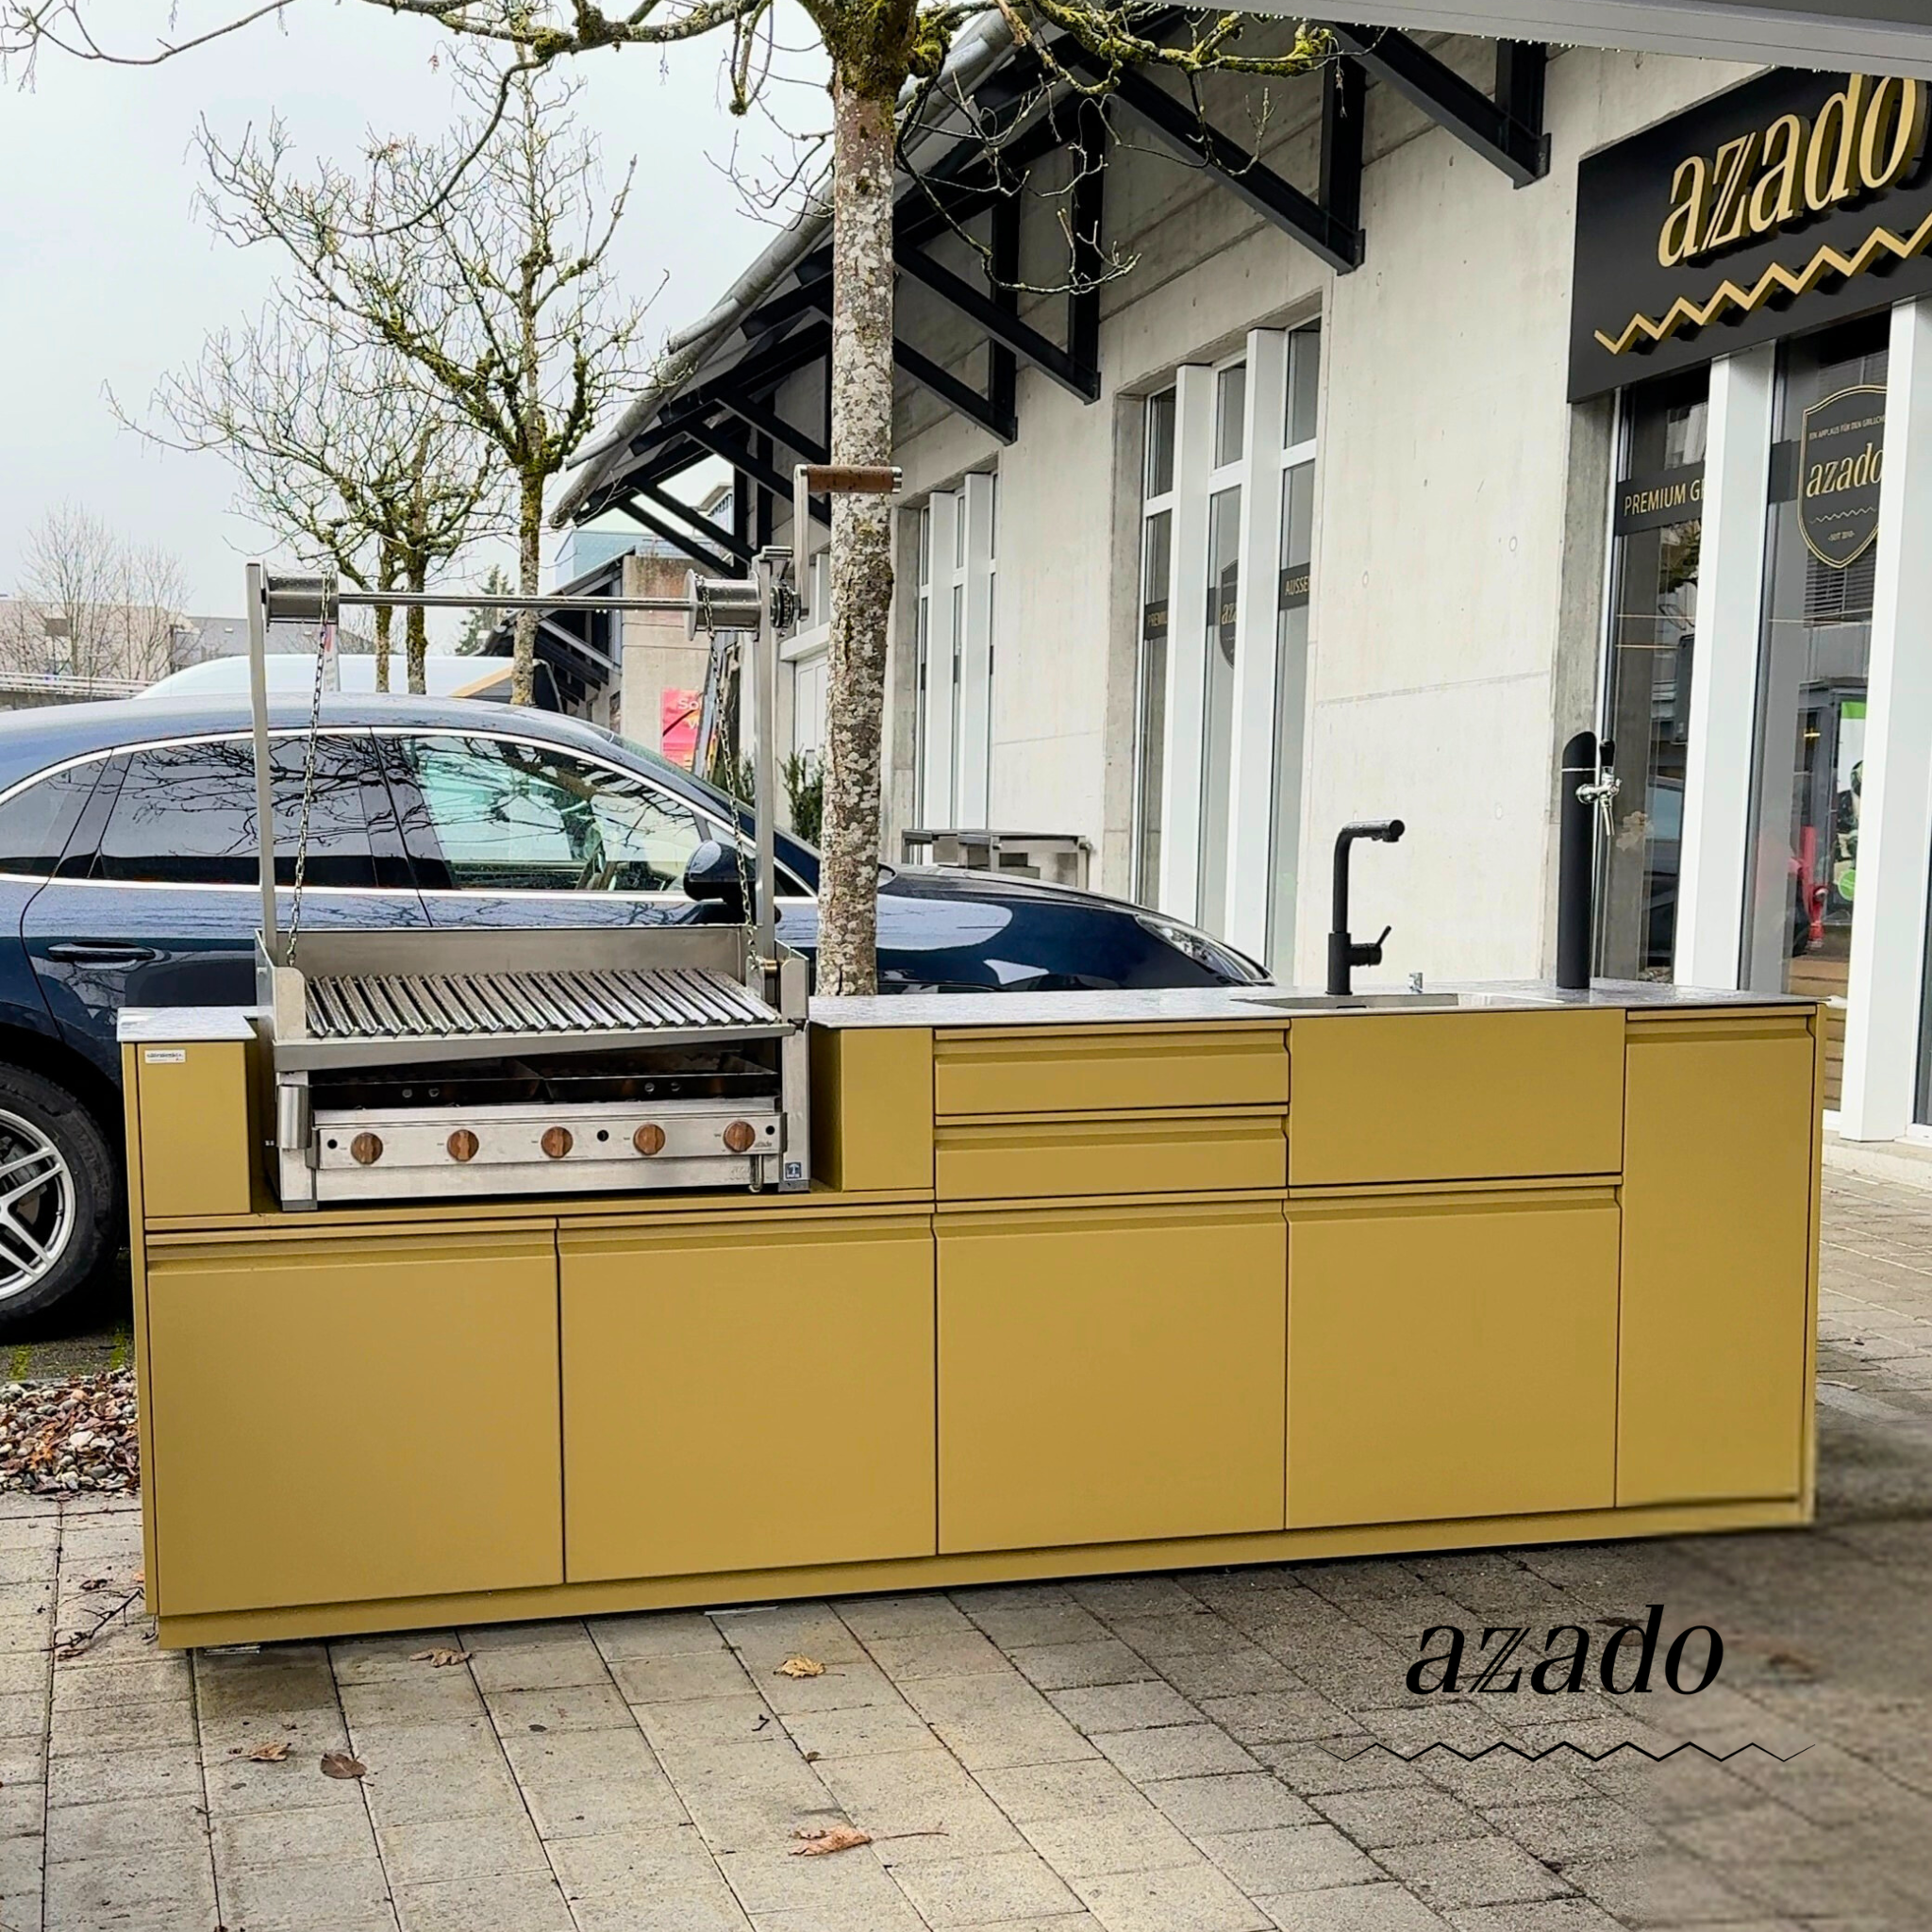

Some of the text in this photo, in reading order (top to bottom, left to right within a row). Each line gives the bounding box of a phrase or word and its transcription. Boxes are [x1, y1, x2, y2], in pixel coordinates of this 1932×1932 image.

[1657, 73, 1918, 268] azado
[1807, 443, 1884, 497] azado
[1624, 482, 1686, 517] PREMIUM
[1285, 575, 1309, 595] AUSSE
